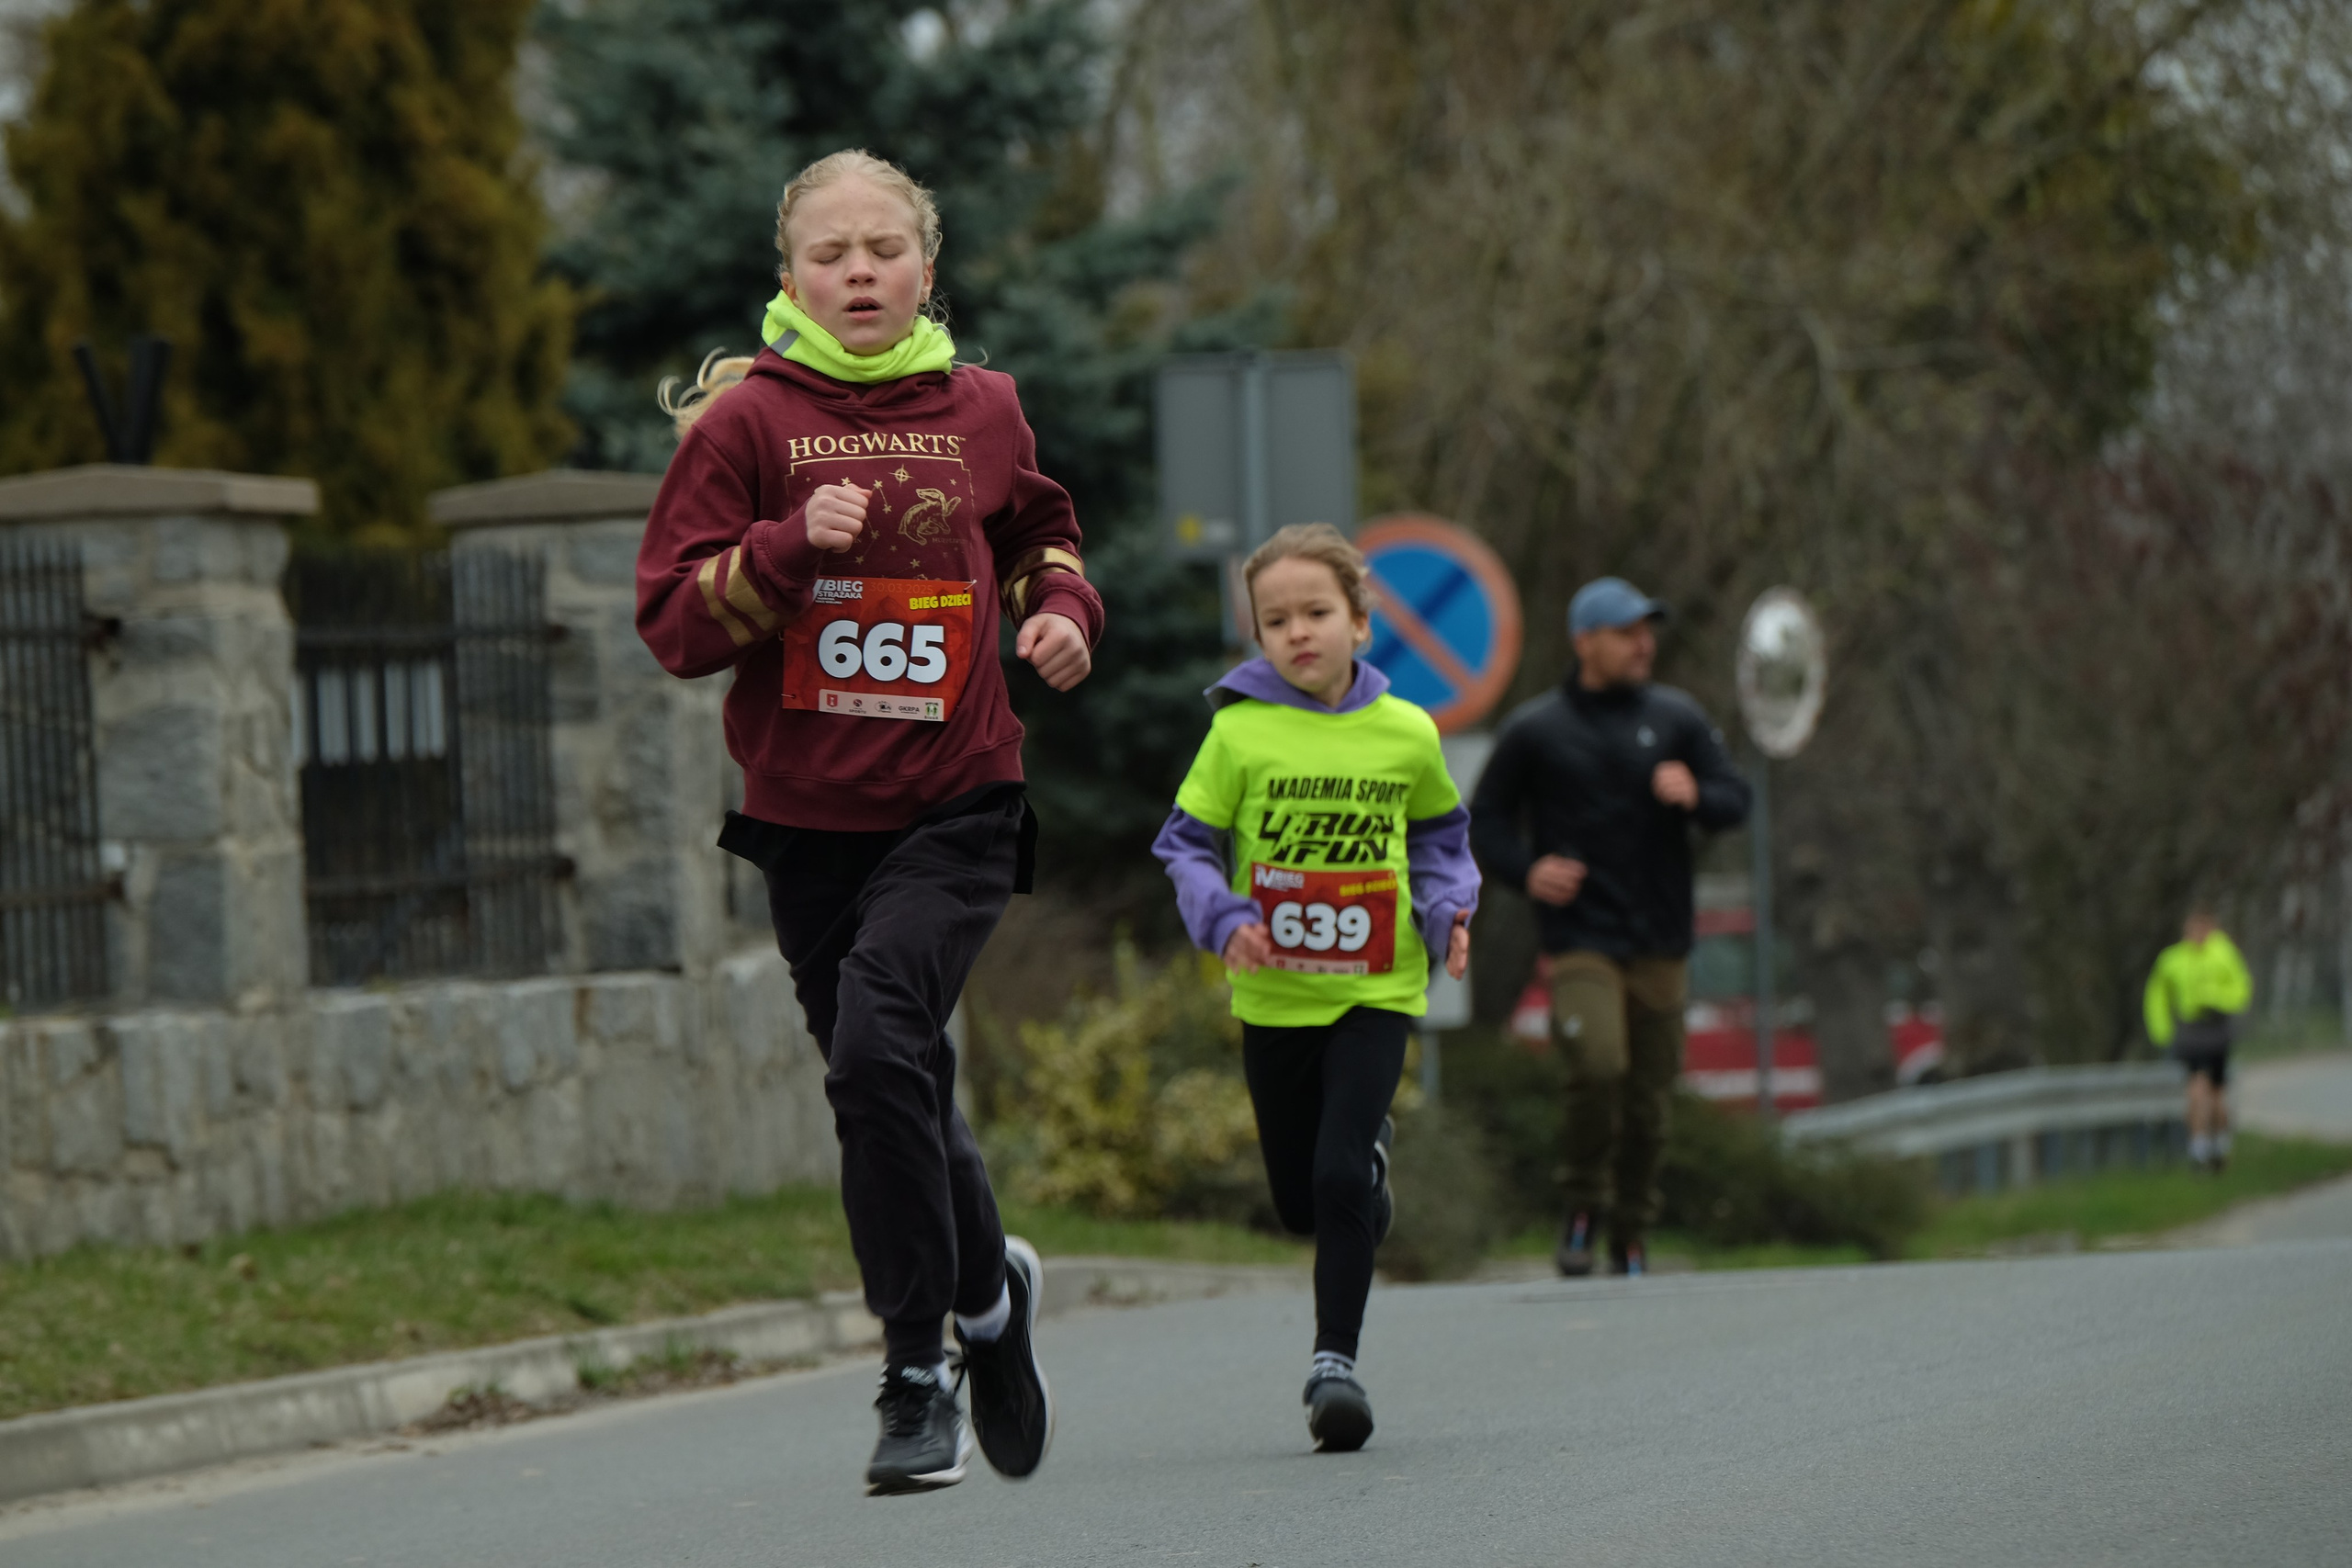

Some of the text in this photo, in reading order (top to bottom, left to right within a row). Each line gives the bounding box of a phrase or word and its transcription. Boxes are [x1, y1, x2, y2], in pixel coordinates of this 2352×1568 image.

[822, 580, 864, 592] BIEG
[909, 593, 971, 610] BIEG DZIECI
[819, 619, 947, 683] 665
[1271, 901, 1372, 952] 639
